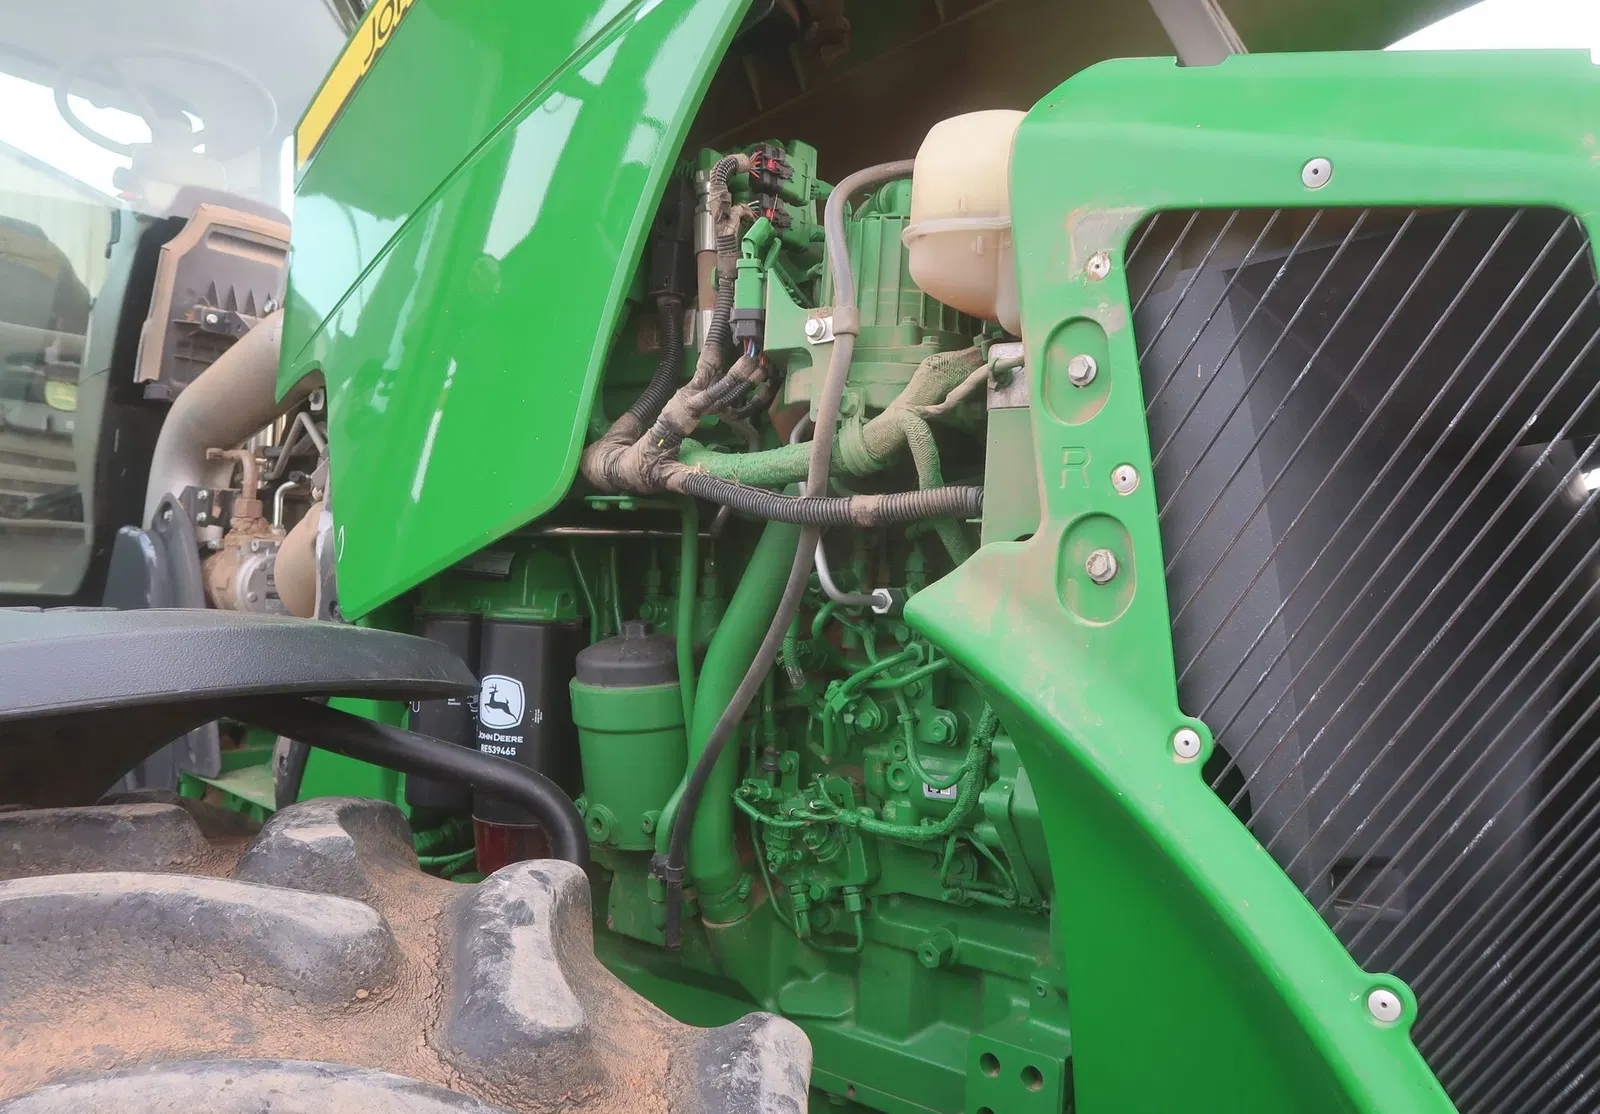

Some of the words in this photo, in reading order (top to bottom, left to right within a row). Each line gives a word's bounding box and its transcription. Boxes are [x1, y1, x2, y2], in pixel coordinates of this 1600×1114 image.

[1059, 446, 1091, 489] R
[478, 731, 493, 741] JOHN
[494, 733, 524, 743] DEERE
[480, 744, 516, 756] RE539465
